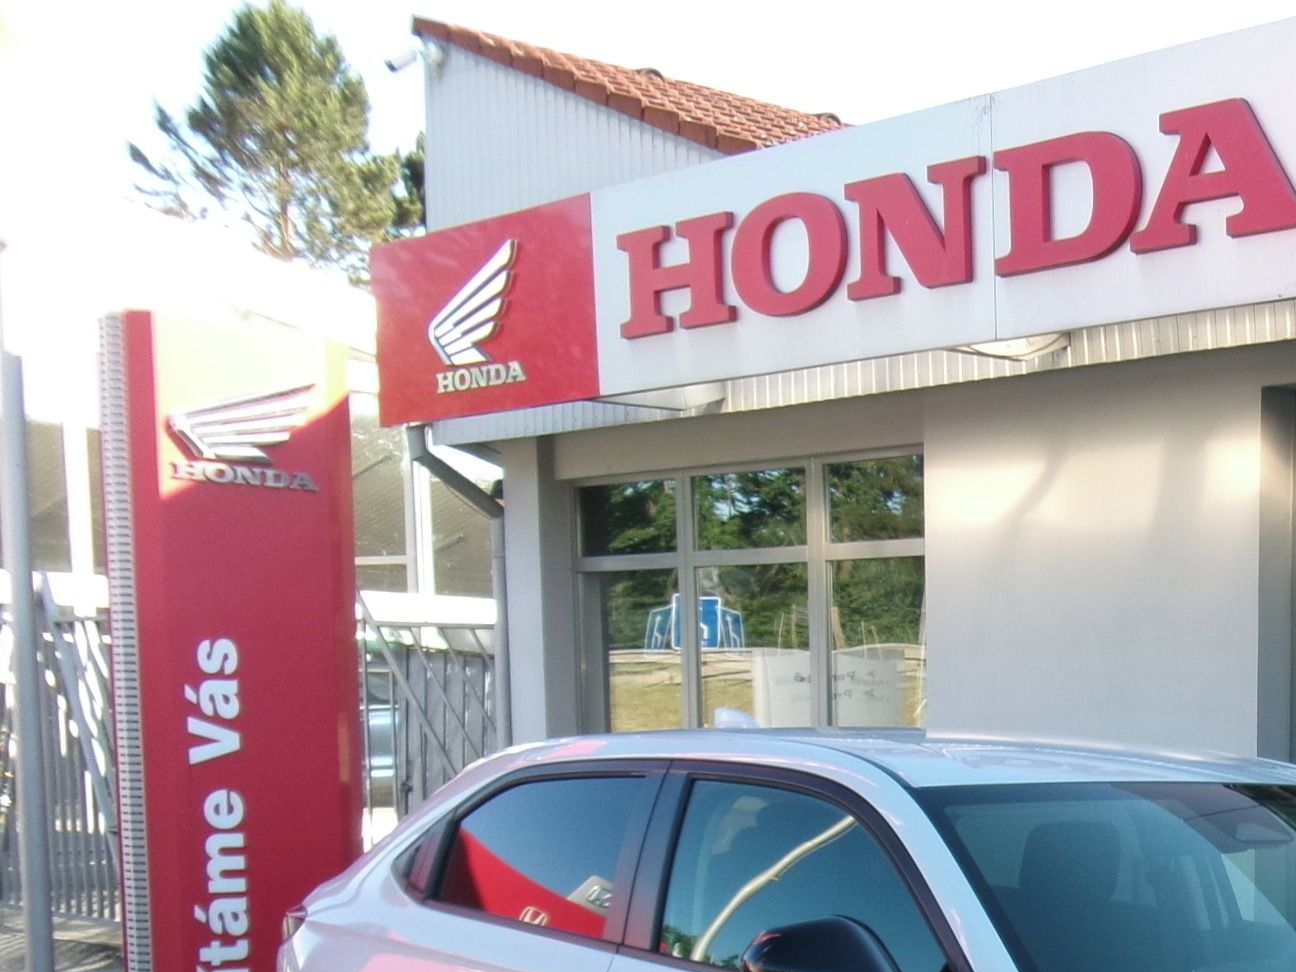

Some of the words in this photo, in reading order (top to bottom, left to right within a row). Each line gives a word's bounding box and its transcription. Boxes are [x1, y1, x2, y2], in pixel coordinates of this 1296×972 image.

[436, 360, 526, 394] HONDA
[169, 461, 319, 492] HONDA
[184, 637, 241, 765] Vás
